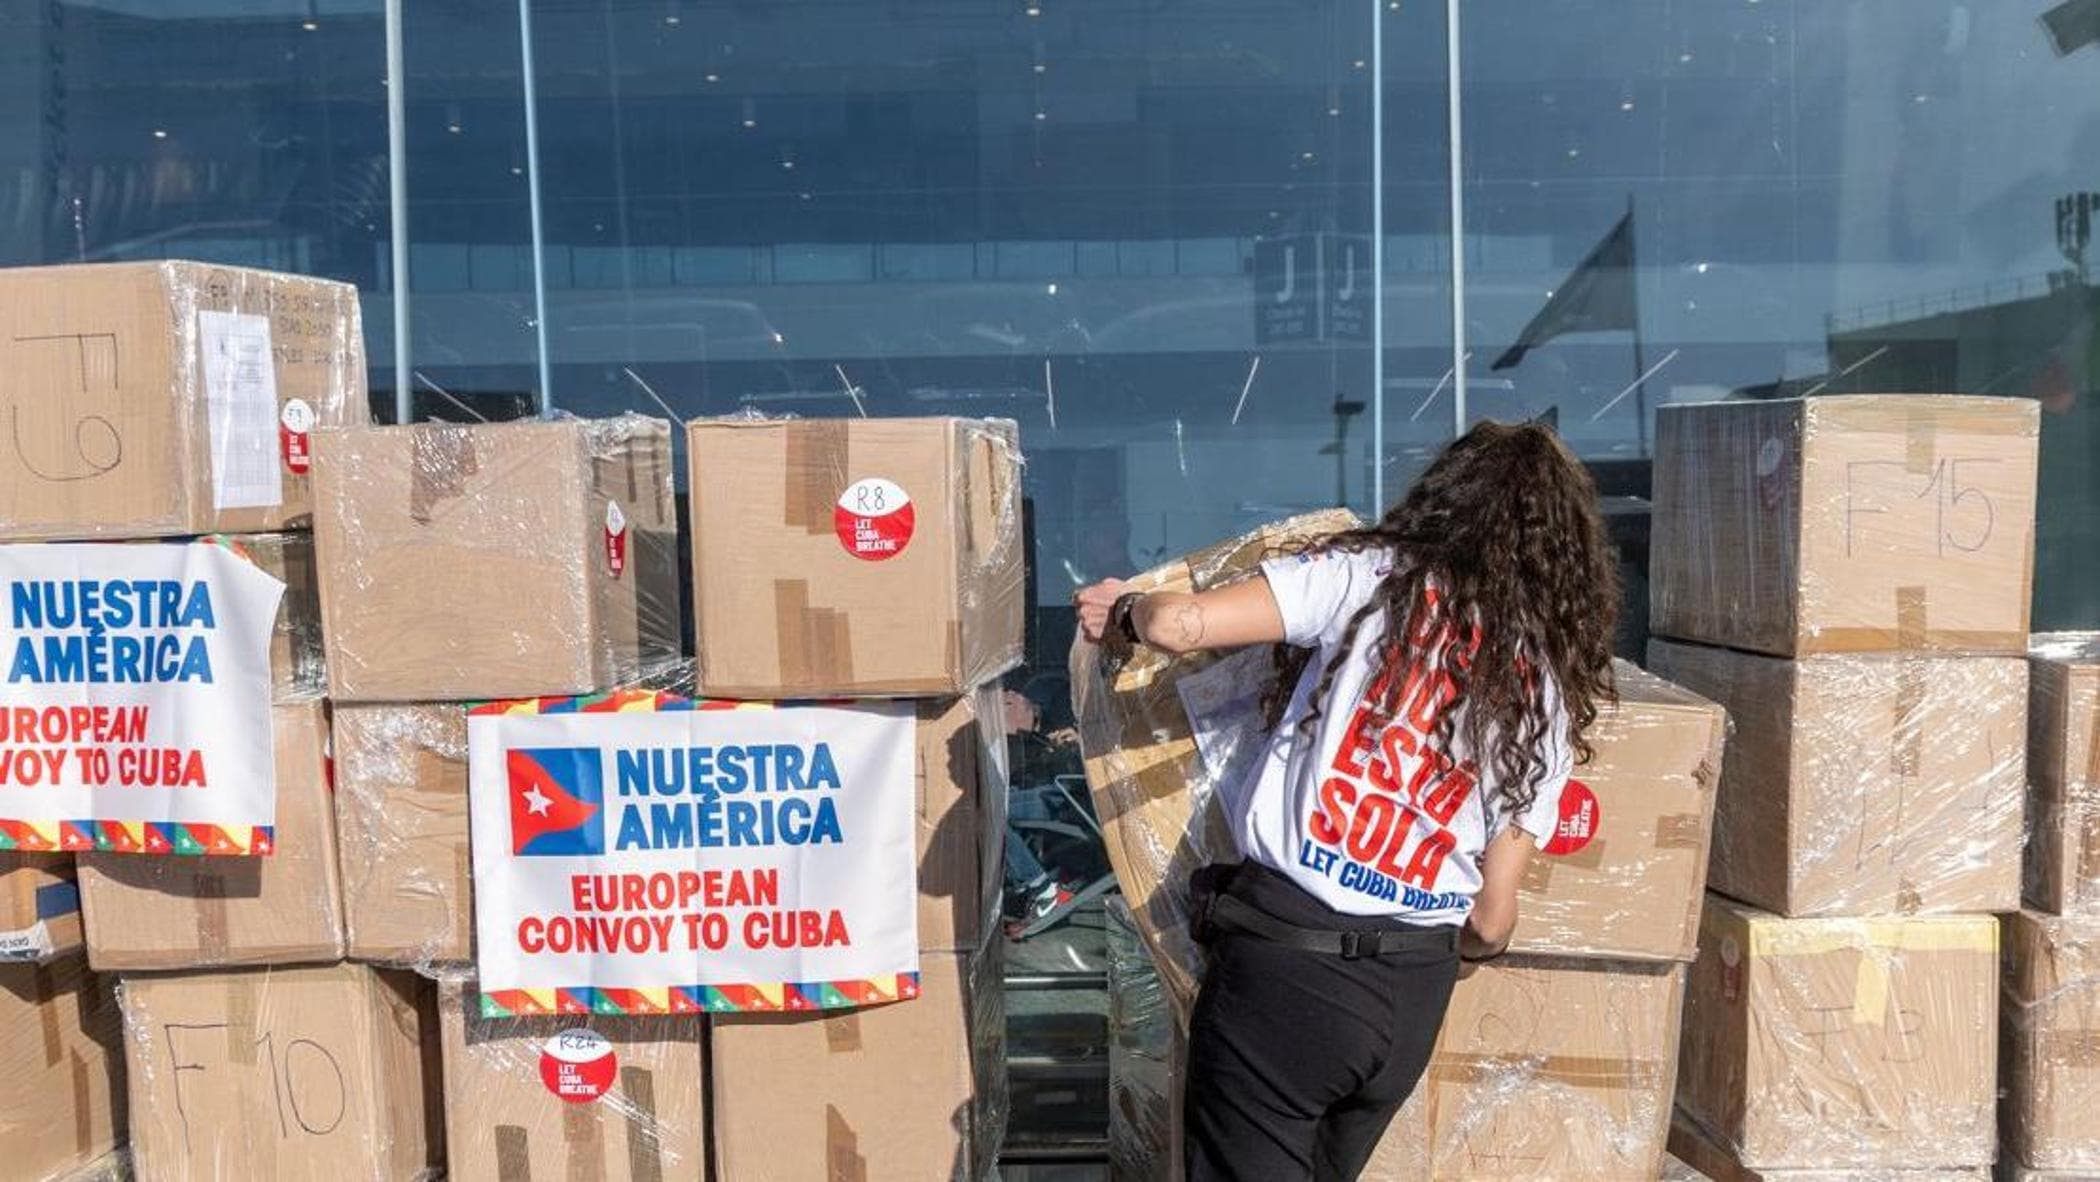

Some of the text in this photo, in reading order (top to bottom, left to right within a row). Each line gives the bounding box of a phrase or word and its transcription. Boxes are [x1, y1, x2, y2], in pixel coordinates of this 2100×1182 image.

[857, 485, 885, 511] R8
[855, 518, 873, 530] LET
[855, 530, 880, 541] CUBA
[855, 539, 898, 552] BREATHE
[12, 579, 215, 629] NUESTRA
[8, 622, 213, 684] AMÉRICA
[75, 748, 110, 785] TO
[118, 748, 206, 788] CUBA
[616, 742, 841, 796] NUESTRA
[616, 788, 843, 850] AMÉRICA
[1308, 777, 1457, 892] SOLA
[1558, 819, 1570, 838] LET
[1578, 798, 1594, 838] BREATHE
[571, 868, 779, 911] EUROPEAN
[1299, 839, 1340, 878] LET
[1338, 861, 1398, 903] CUBA
[518, 908, 850, 954] CONVOY TO CUBA
[558, 1063, 577, 1075] LET
[558, 1075, 585, 1086] CUBA
[558, 1085, 600, 1095] BREATHE
